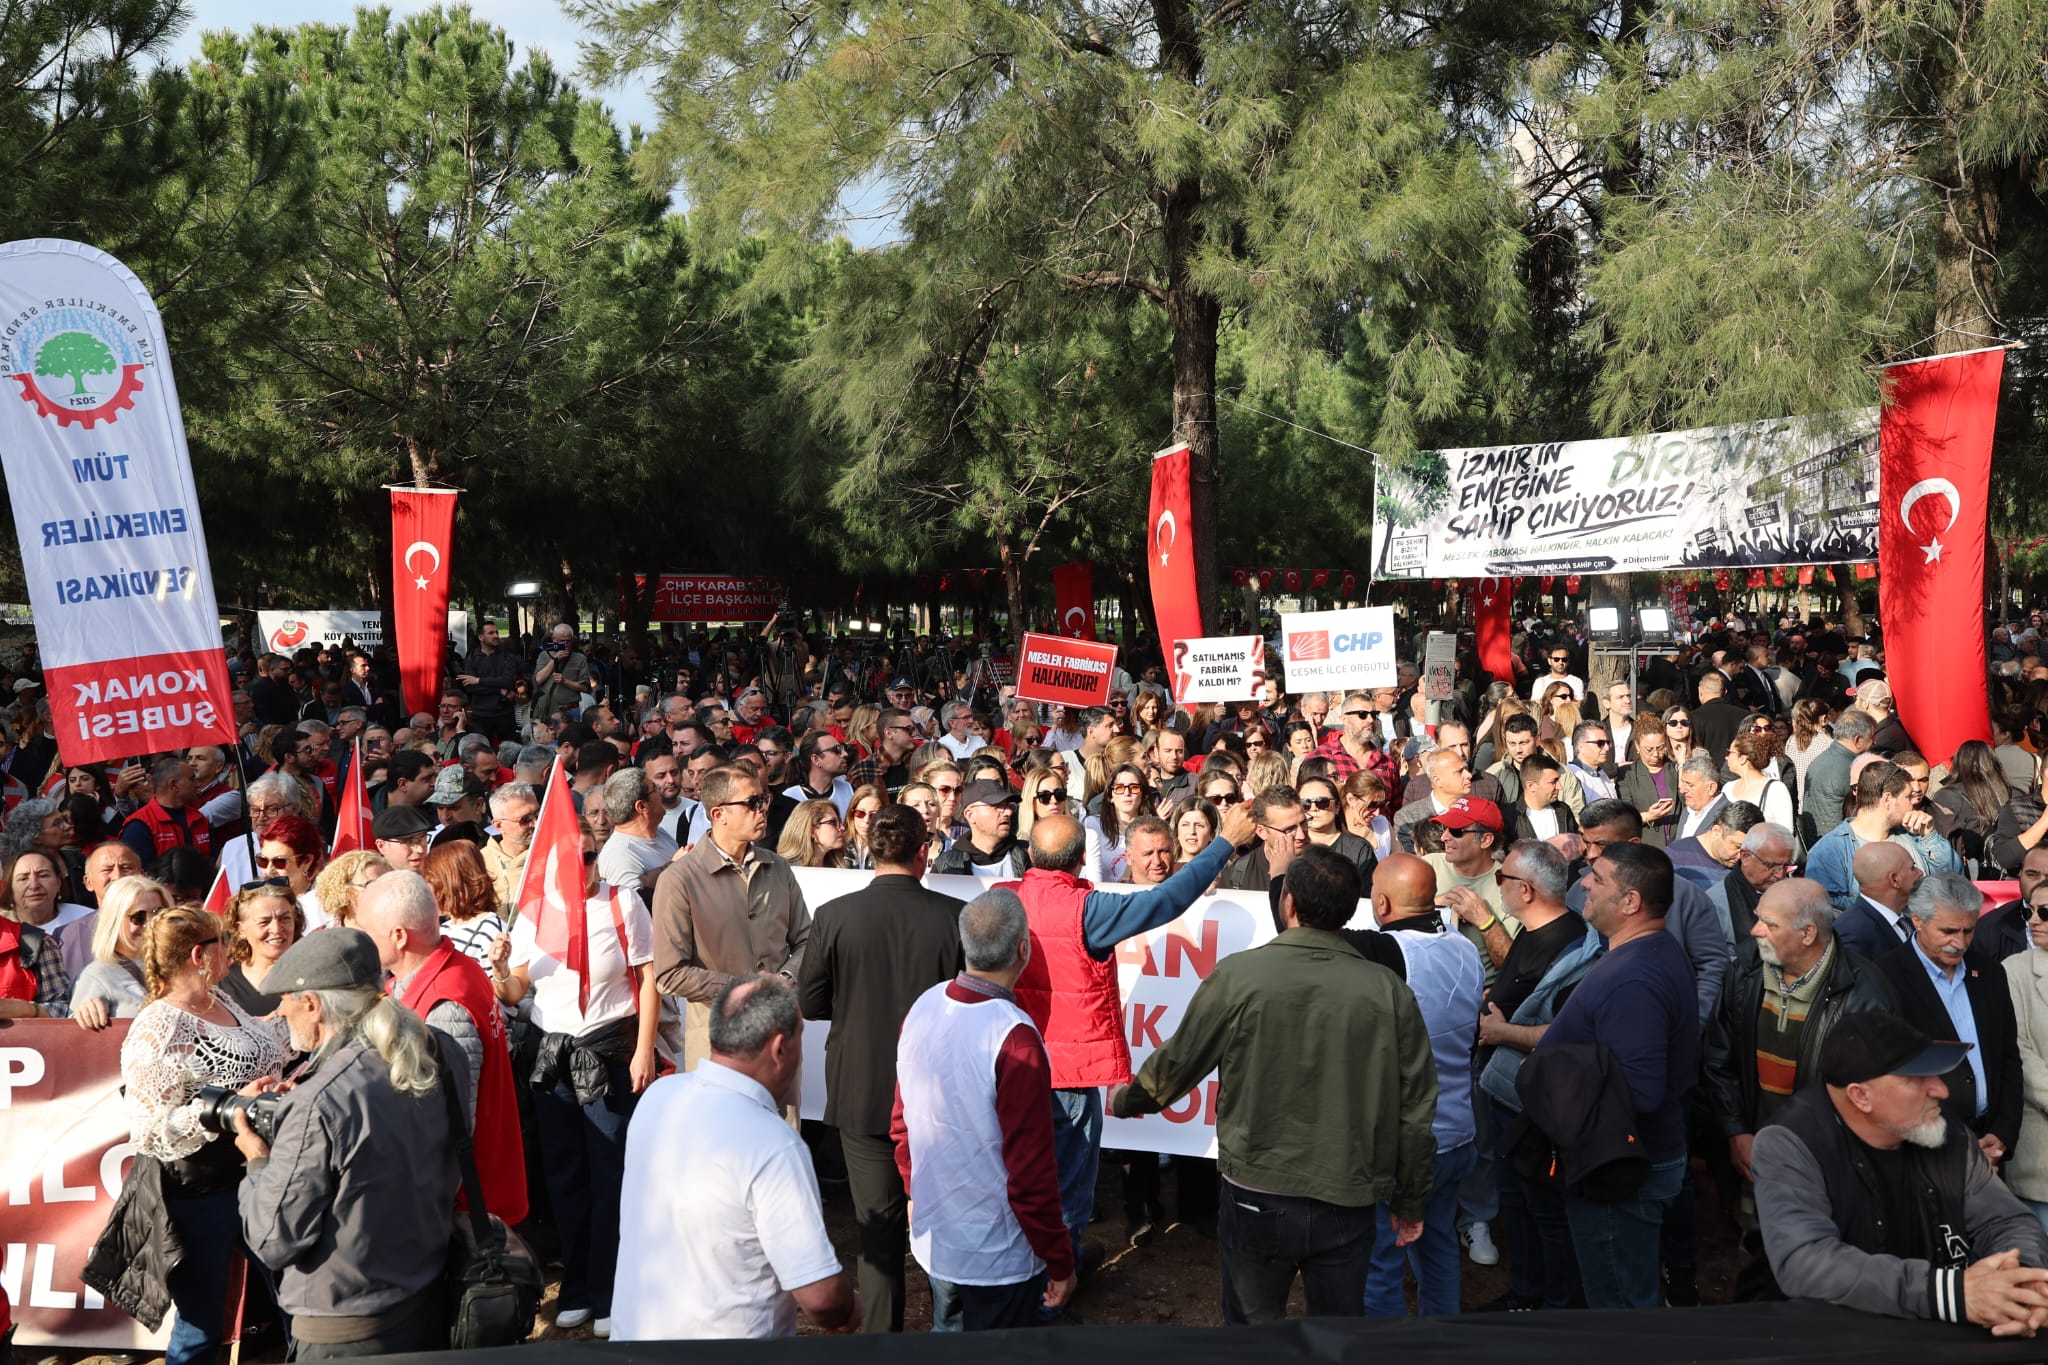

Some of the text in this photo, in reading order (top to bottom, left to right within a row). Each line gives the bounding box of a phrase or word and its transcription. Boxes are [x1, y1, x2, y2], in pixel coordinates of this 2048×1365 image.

[1458, 465, 1574, 511] EMEĞİNE
[1445, 504, 1524, 544] SAHİP
[1443, 551, 1479, 562] MESLEK
[1586, 536, 1620, 548] HALKIN
[1623, 528, 1674, 543] KALACAK!
[1573, 561, 1591, 569] SAHİP
[665, 580, 693, 592] CHP
[671, 592, 702, 606] İLÇE
[1333, 631, 1383, 653] CHP
[1027, 651, 1108, 674] MESLEK FABRİKASI
[1192, 652, 1246, 663] SATILMAMIŞ
[1200, 663, 1238, 674] FABRİKA
[1291, 666, 1324, 677] ÇEŞME
[1326, 663, 1348, 675] İLÇE
[1031, 666, 1099, 693] HALKINDIR!
[1198, 677, 1241, 688] KALDI MI?
